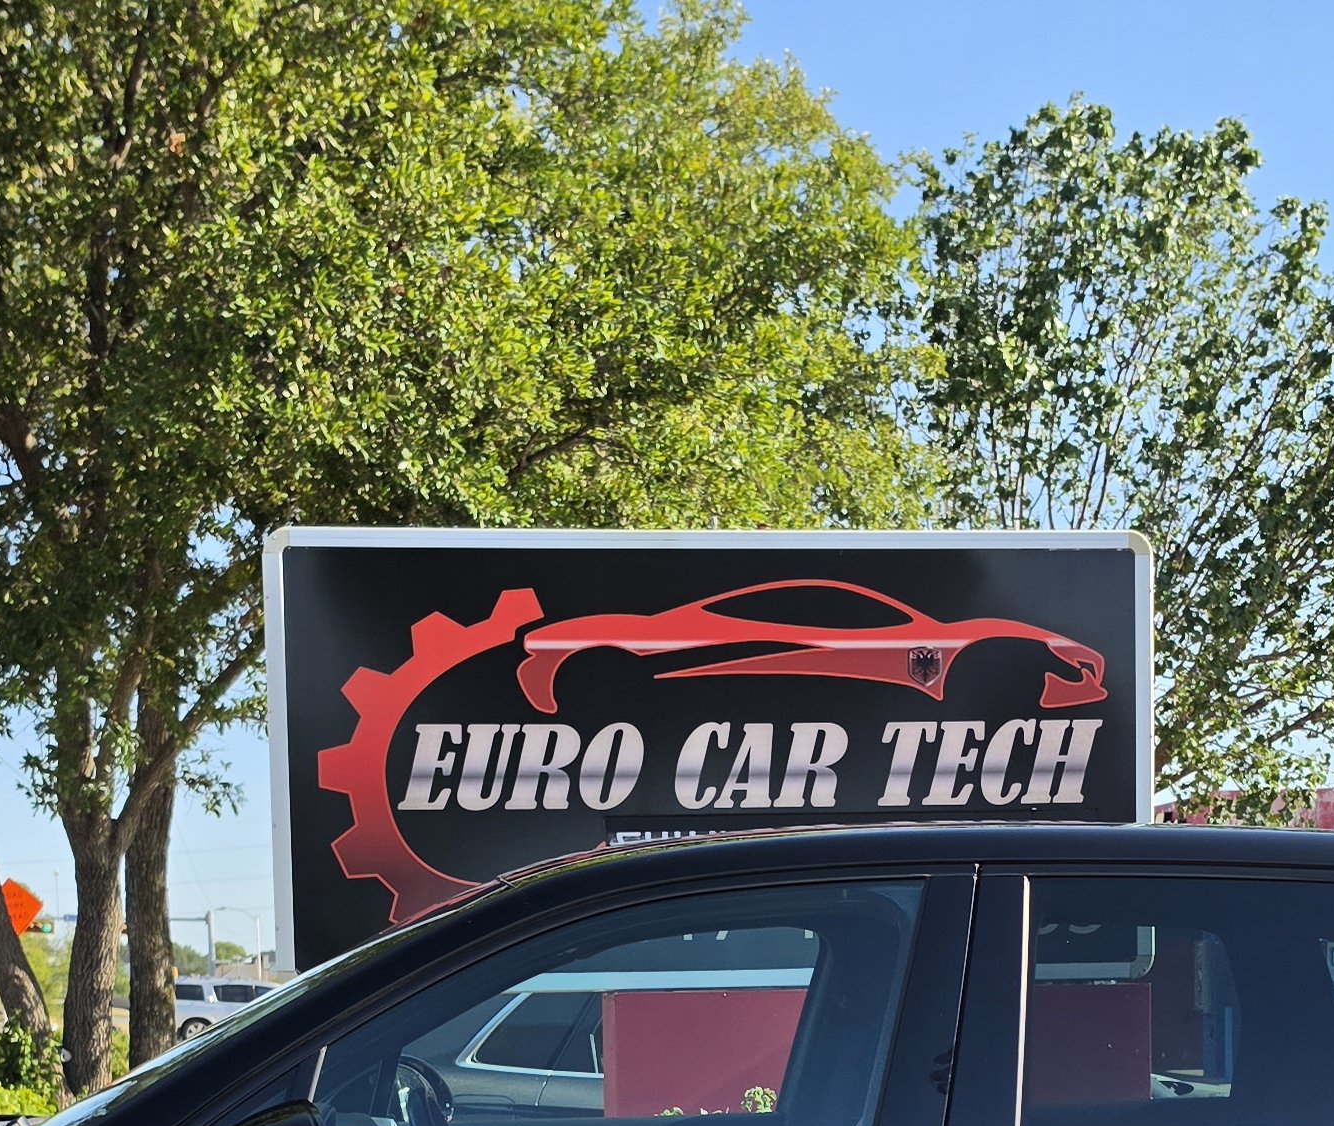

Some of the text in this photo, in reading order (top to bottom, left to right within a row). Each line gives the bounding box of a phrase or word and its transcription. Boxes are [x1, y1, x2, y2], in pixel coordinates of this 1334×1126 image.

[398, 719, 1104, 811] EURO CAR TECH
